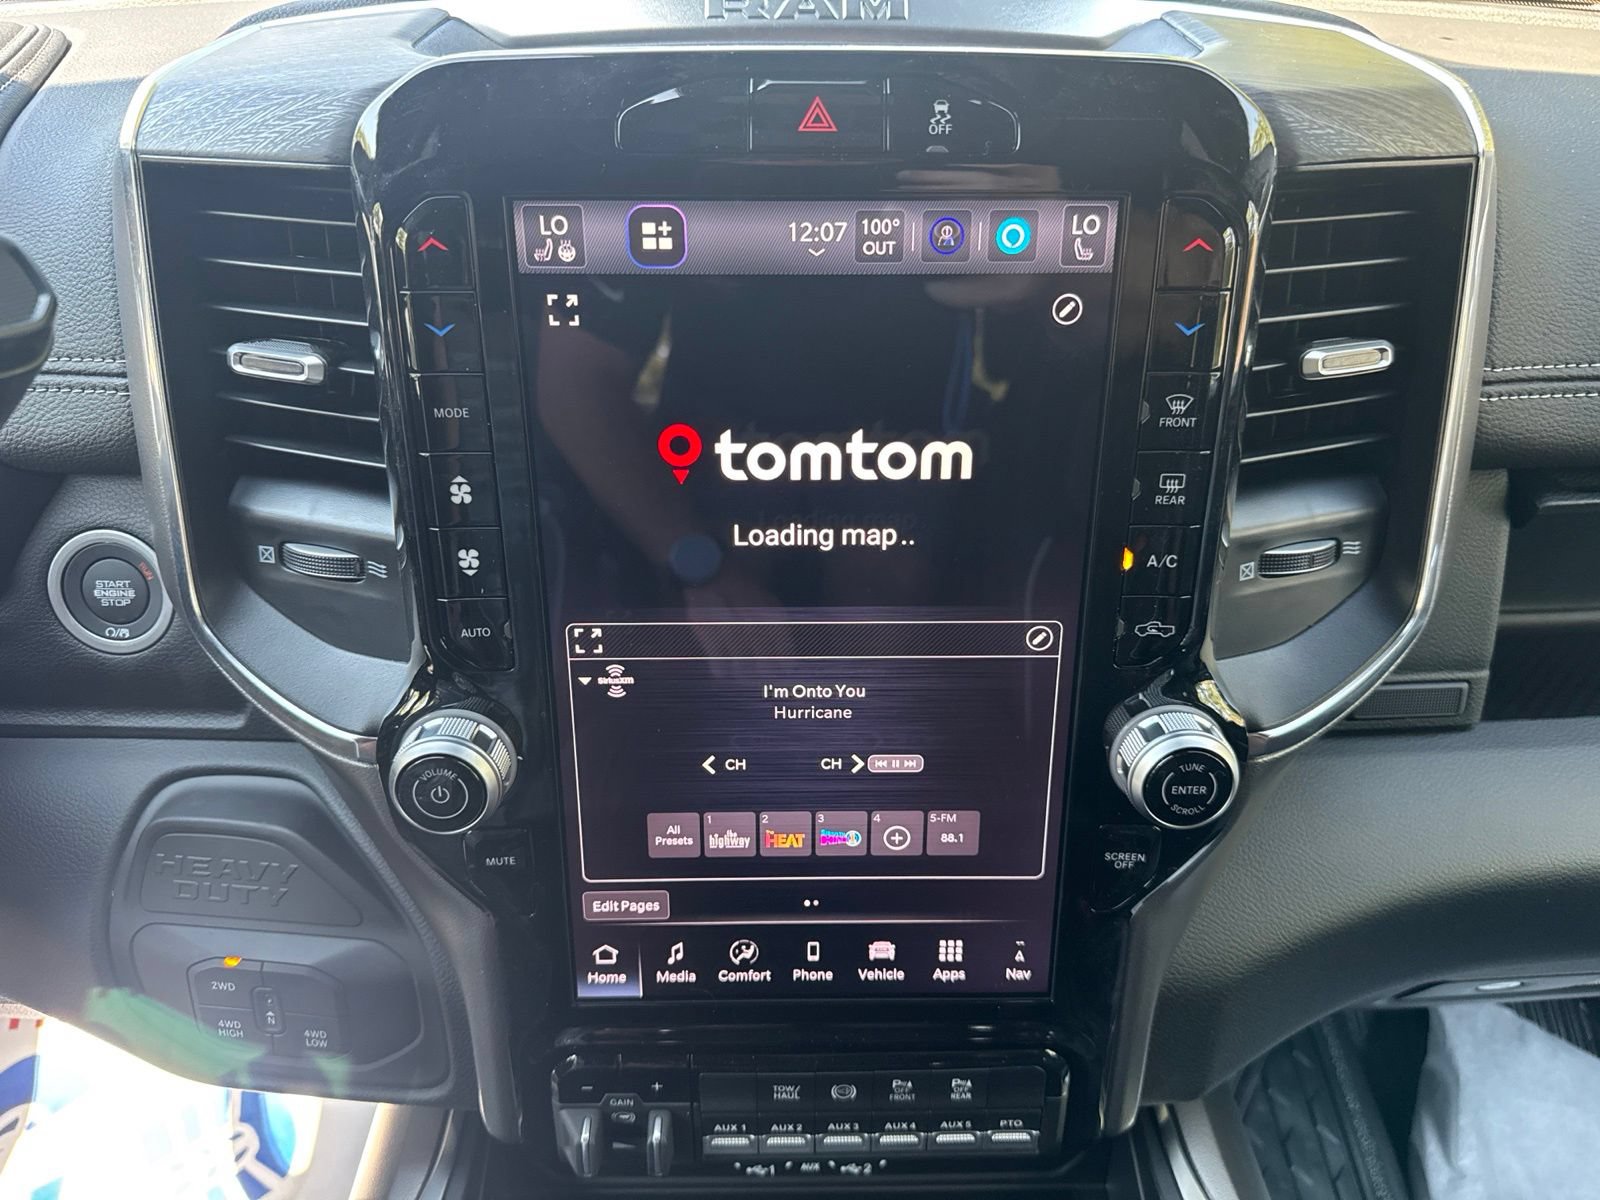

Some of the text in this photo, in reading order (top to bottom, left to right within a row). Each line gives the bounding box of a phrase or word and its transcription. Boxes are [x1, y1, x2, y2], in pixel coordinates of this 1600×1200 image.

[703, 0, 910, 20] RAM
[928, 123, 953, 135] OFF
[539, 214, 569, 236] LO
[861, 218, 901, 236] 100°
[1071, 214, 1100, 235] LO
[788, 221, 848, 242] 12:07
[862, 241, 896, 255] OUT
[433, 408, 470, 418] MODE
[1159, 417, 1198, 428] FRONT
[713, 428, 974, 481] tomtom
[1154, 495, 1186, 505] REAR
[733, 523, 835, 551] Loading
[1146, 554, 1178, 568] A/C
[95, 580, 131, 588] START
[93, 589, 136, 598] ENGINE
[101, 598, 131, 607] STOP
[460, 628, 491, 638] AUTO
[763, 684, 866, 699] I'm Onto You
[774, 705, 853, 719] Hurricane
[725, 758, 746, 770] CH
[820, 757, 842, 769] CH
[1179, 762, 1206, 773] TUNE
[419, 768, 458, 782] VOLUME
[1171, 785, 1207, 795] ENTER
[1170, 804, 1205, 815] SCROLL
[707, 815, 712, 824] 1
[761, 815, 769, 824] 2
[817, 814, 825, 823] 3
[873, 814, 881, 823] 4
[929, 813, 957, 823] 5-FM
[666, 825, 681, 835] All
[655, 836, 694, 846] Presets
[765, 831, 806, 848] HEAT
[940, 833, 964, 843] 88.1
[486, 856, 517, 866] MUTE
[1104, 852, 1146, 862] SCREEN
[153, 853, 299, 884] HEAVY
[1114, 861, 1135, 869] OFF
[171, 879, 289, 908] DUTY
[592, 900, 661, 914] Edit Pages
[587, 971, 627, 984] Home
[656, 970, 697, 983] Media
[718, 969, 772, 982] Comfort
[792, 968, 833, 982] Phone
[857, 968, 905, 981] Vehicle
[932, 968, 967, 983] Apps
[1005, 967, 1032, 981] Nav
[211, 981, 236, 991] 2WD
[218, 1019, 242, 1029] 4WD
[218, 1028, 244, 1038] HIGH
[304, 1029, 327, 1039] 4WD
[305, 1038, 328, 1048] LOW
[773, 1084, 801, 1092] TOW/
[773, 1091, 801, 1100] HAUL
[889, 1093, 916, 1101] FRONT
[609, 1098, 634, 1107] GAIN
[714, 1123, 747, 1132] AUX 1
[771, 1123, 803, 1132] AUX 2
[827, 1122, 859, 1131] AUX 3
[884, 1121, 917, 1130] AUX 4
[940, 1120, 962, 1129] AUX
[1000, 1119, 1024, 1128] PTO
